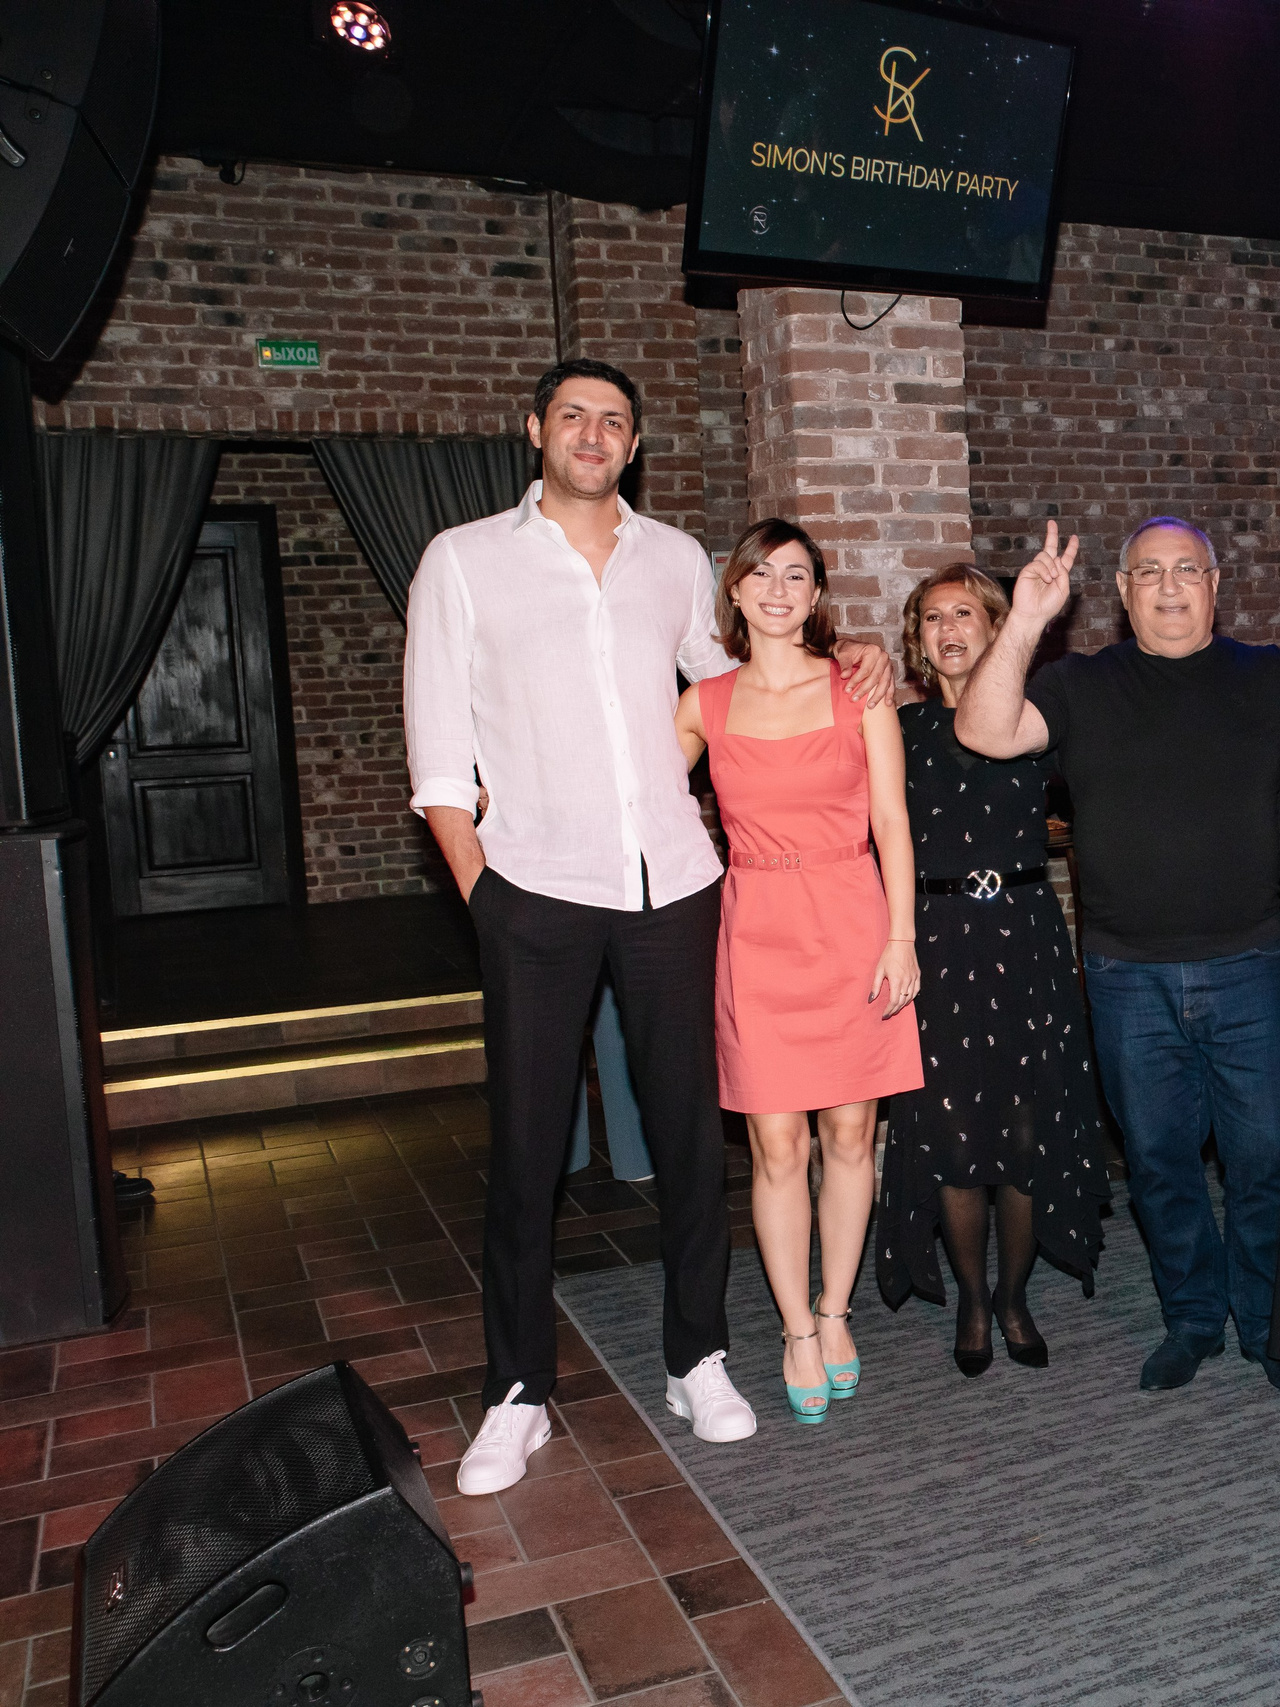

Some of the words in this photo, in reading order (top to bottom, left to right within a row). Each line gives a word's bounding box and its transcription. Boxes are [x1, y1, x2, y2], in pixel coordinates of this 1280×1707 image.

[751, 142, 845, 177] SIMON'S
[850, 156, 953, 192] BIRTHDAY
[956, 171, 1019, 201] PARTY
[261, 346, 318, 363] ВЫХОД
